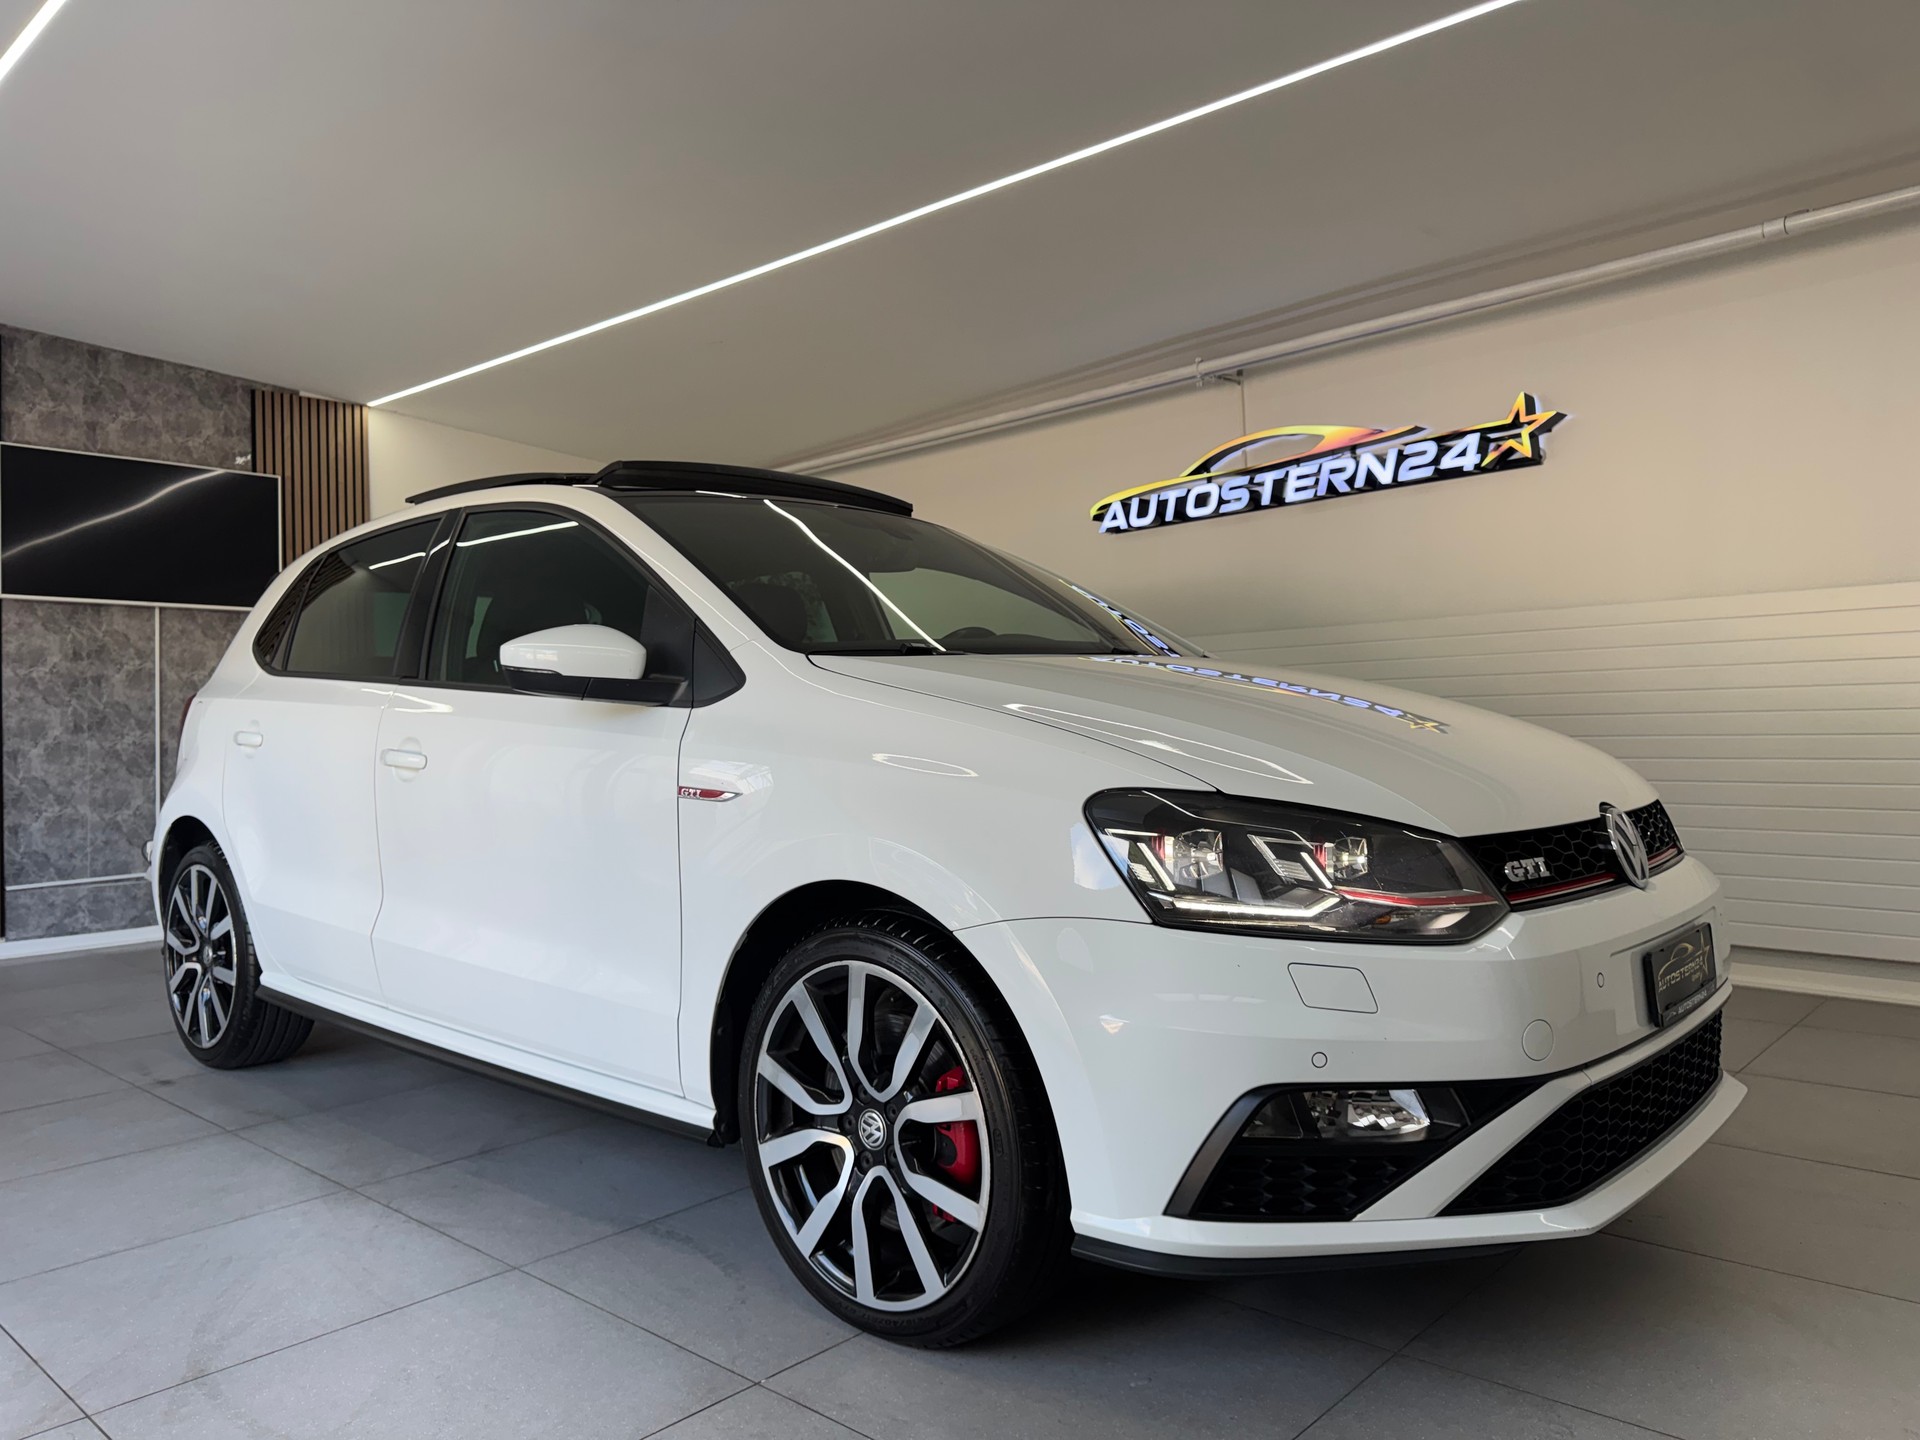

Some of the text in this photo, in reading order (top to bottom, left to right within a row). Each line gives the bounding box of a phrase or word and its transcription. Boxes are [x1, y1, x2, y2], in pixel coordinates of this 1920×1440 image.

[1099, 432, 1482, 533] AUTOSTERN24
[681, 788, 701, 797] GTI
[1504, 856, 1551, 883] GTI
